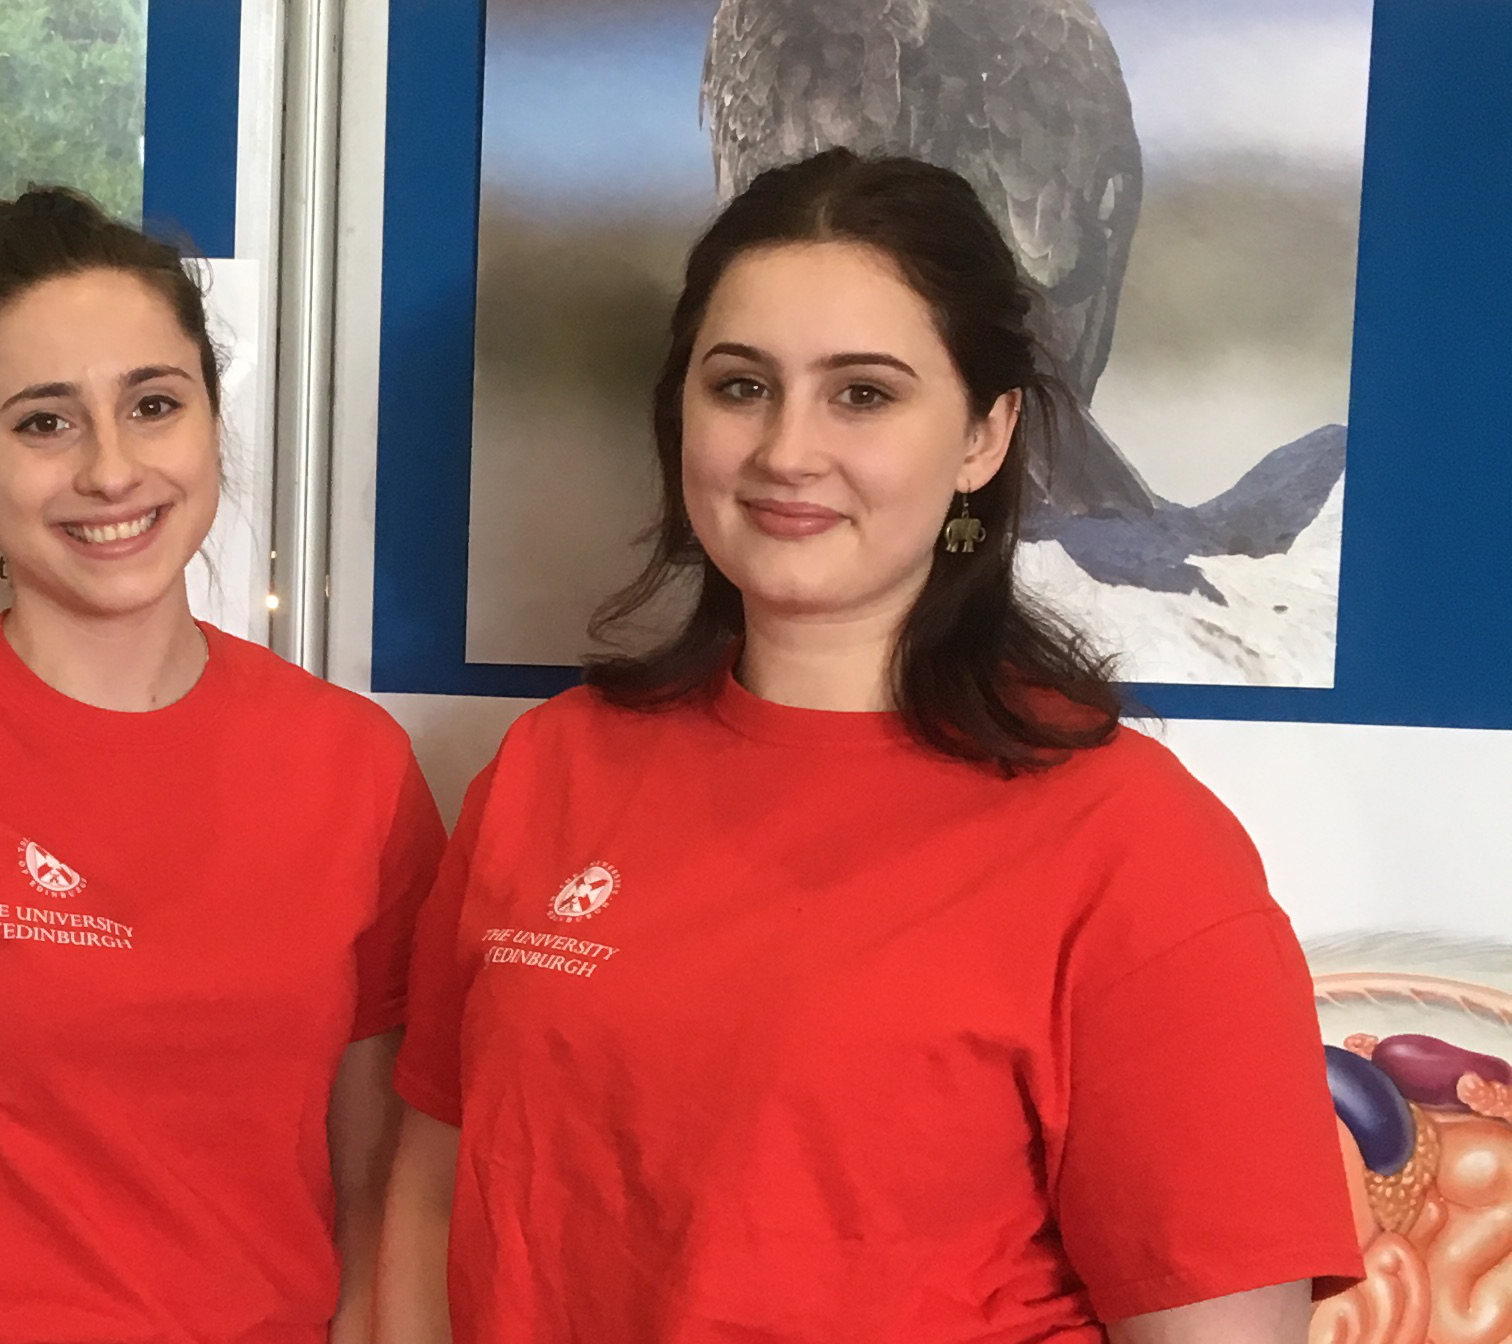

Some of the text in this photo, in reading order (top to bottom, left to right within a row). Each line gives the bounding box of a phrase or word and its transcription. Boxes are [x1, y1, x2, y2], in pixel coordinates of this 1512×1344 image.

[2, 922, 134, 949] EDINBURGH
[15, 906, 134, 938] UNIVERSITY
[482, 928, 621, 961] THE UNIVERSITY
[491, 946, 598, 978] EDINBURGH
